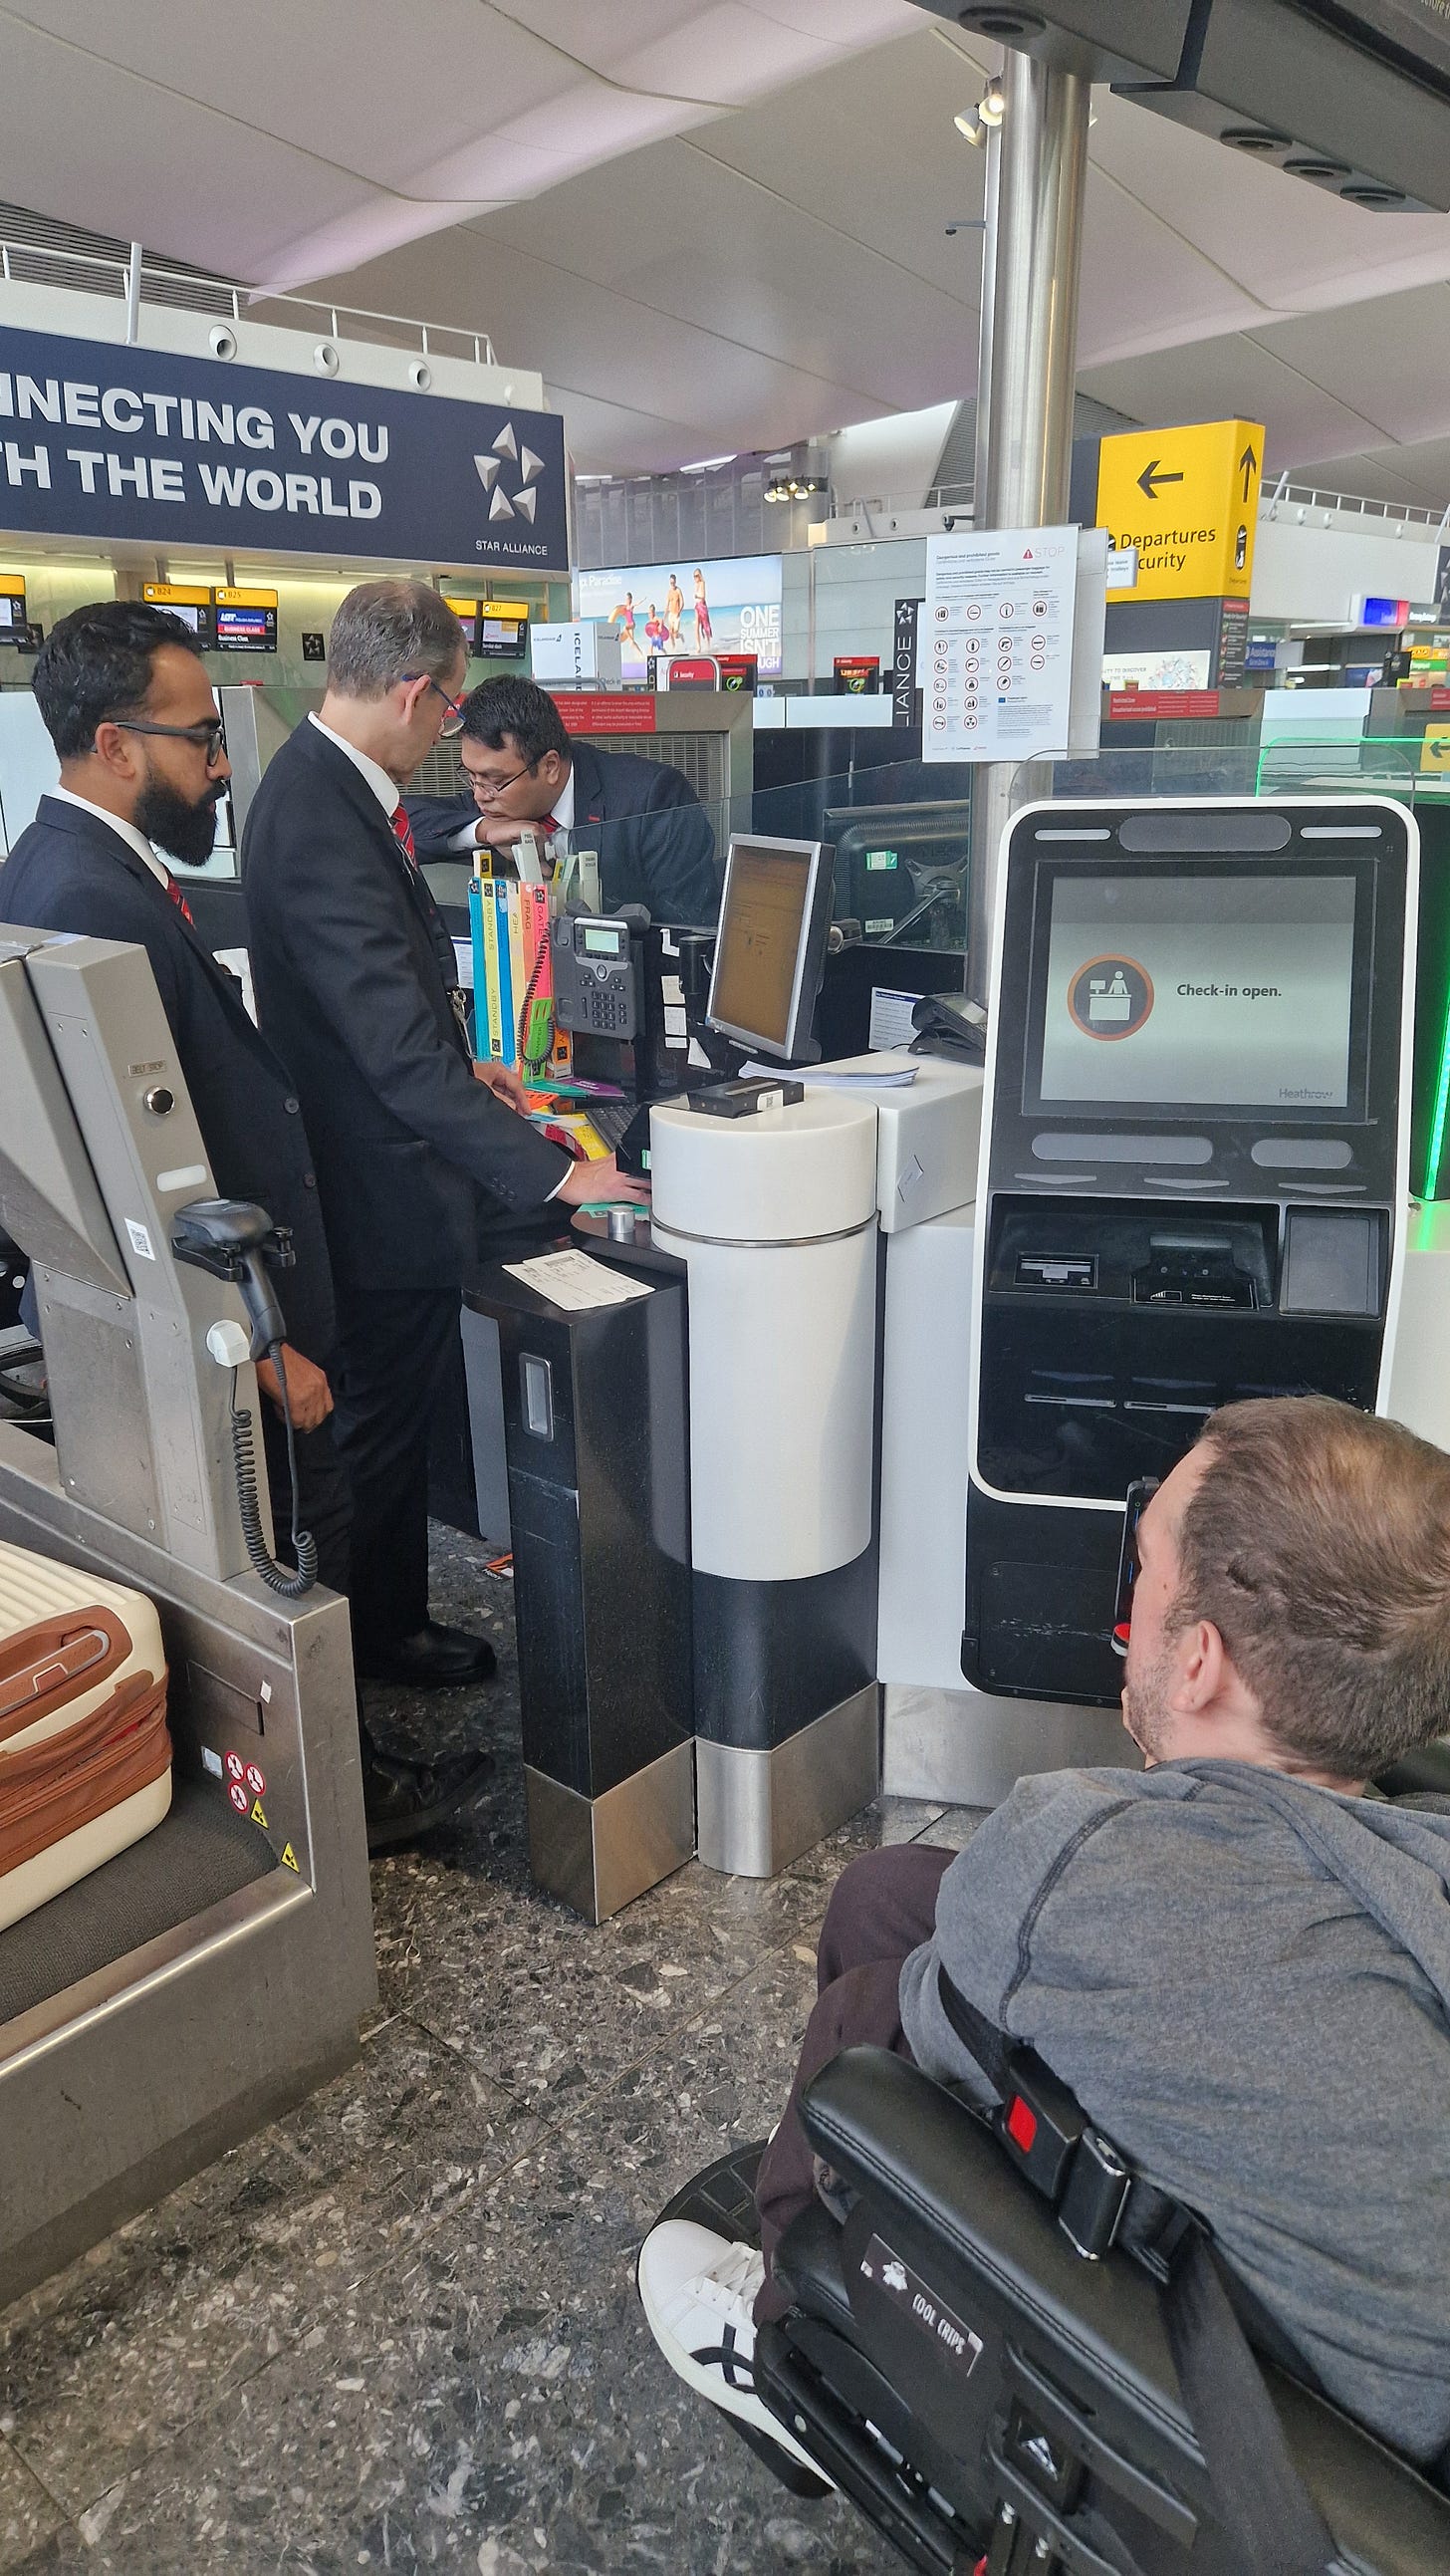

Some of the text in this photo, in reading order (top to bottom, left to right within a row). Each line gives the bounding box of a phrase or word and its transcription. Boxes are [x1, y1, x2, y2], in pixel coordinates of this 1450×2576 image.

[288, 412, 388, 463] YOU
[0, 441, 382, 519] H THE WORLD
[475, 540, 548, 556] STAR ALLIANCE
[1120, 528, 1216, 551] Departures
[1035, 546, 1066, 558] STOP
[1138, 552, 1186, 571] curity
[740, 606, 781, 628] ONE
[740, 627, 780, 639] SUMMER
[740, 639, 780, 657] ISN'T
[758, 656, 780, 669] UGH
[488, 899, 497, 951] STANDBY
[1176, 984, 1282, 1000] Check-in open.
[1279, 1088, 1333, 1100] Heathrow
[912, 2293, 966, 2355] COOL CRIPS
